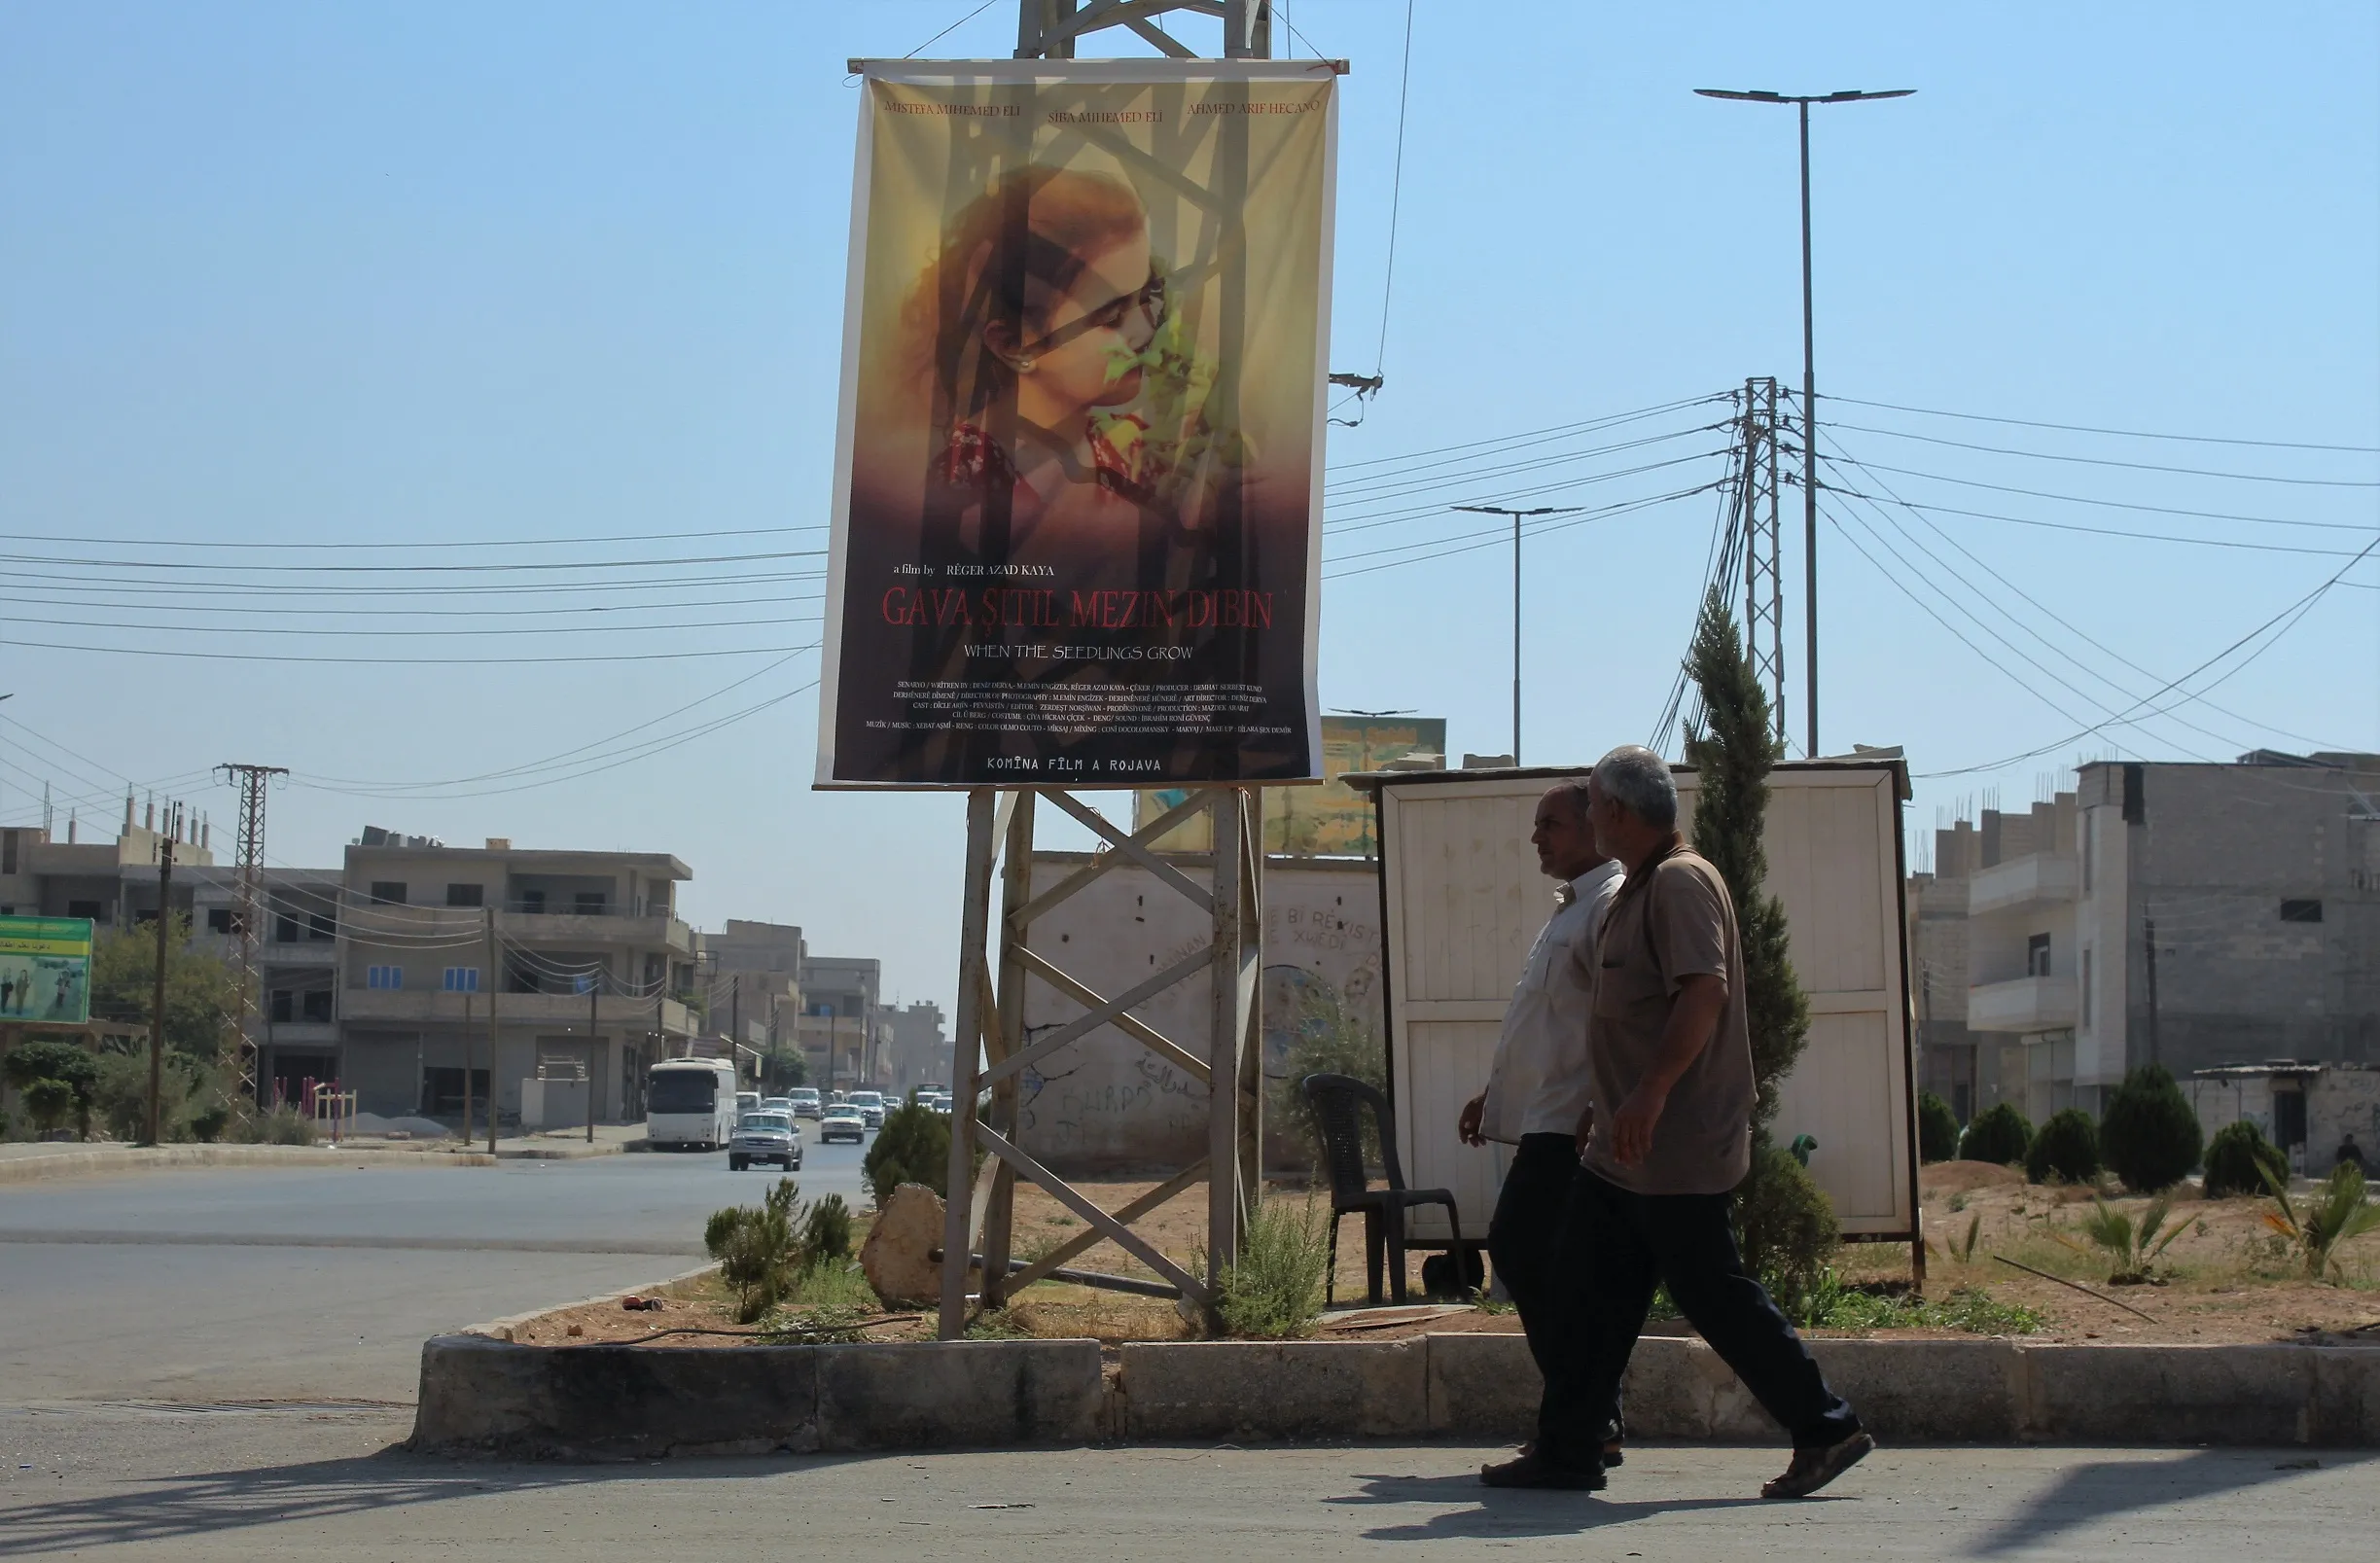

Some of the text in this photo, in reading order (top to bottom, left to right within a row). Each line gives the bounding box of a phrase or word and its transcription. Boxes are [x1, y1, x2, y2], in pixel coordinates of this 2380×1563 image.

[1187, 103, 1234, 115] AHMED
[1079, 112, 1141, 124] MIHEMED
[902, 563, 921, 575] film
[923, 565, 935, 577] by
[986, 565, 1018, 576] AZAD
[1021, 565, 1054, 576] KAYA
[882, 586, 973, 626] GAVA
[1186, 589, 1273, 630] DIBIN
[965, 644, 1193, 659] WHEN THE SEEDLINGS GROW
[1092, 760, 1100, 770] A
[1110, 760, 1161, 771] ROJAVA
